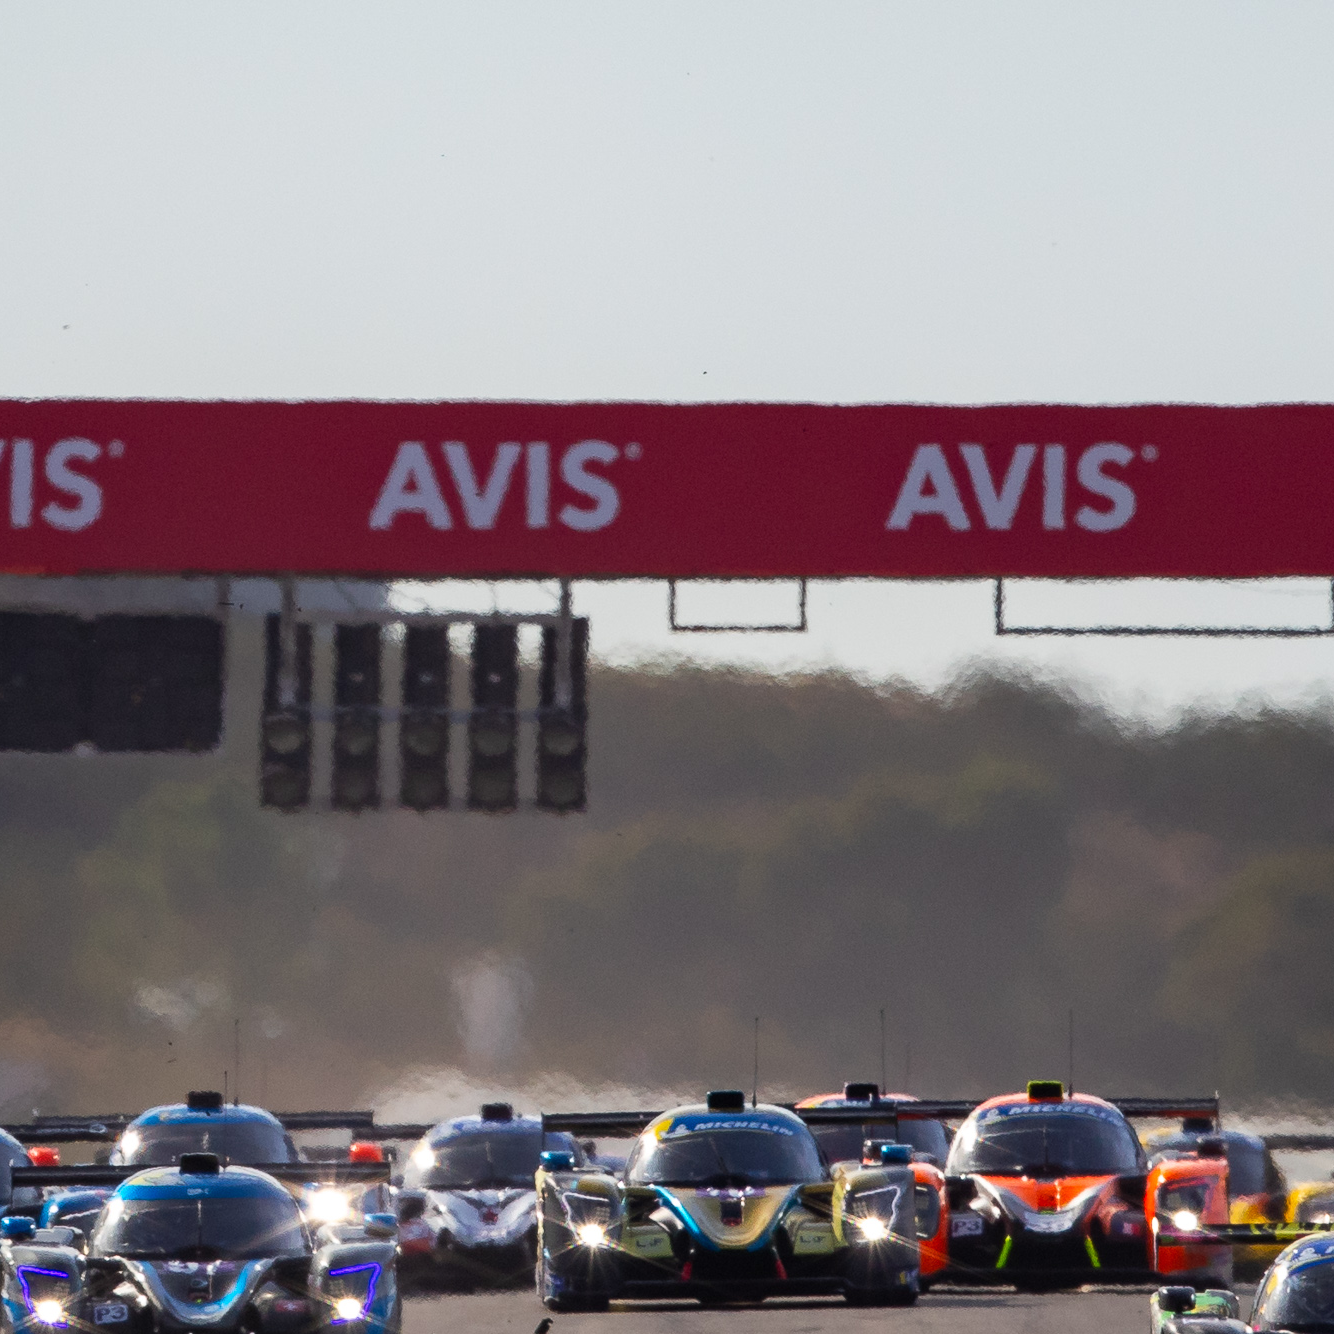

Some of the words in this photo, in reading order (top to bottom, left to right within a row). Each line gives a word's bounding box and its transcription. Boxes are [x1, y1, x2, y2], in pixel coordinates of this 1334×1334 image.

[369, 440, 620, 532] AVIS
[886, 442, 1136, 532] AVIS
[693, 1120, 794, 1136] MICHELIN
[97, 1305, 126, 1321] P3
